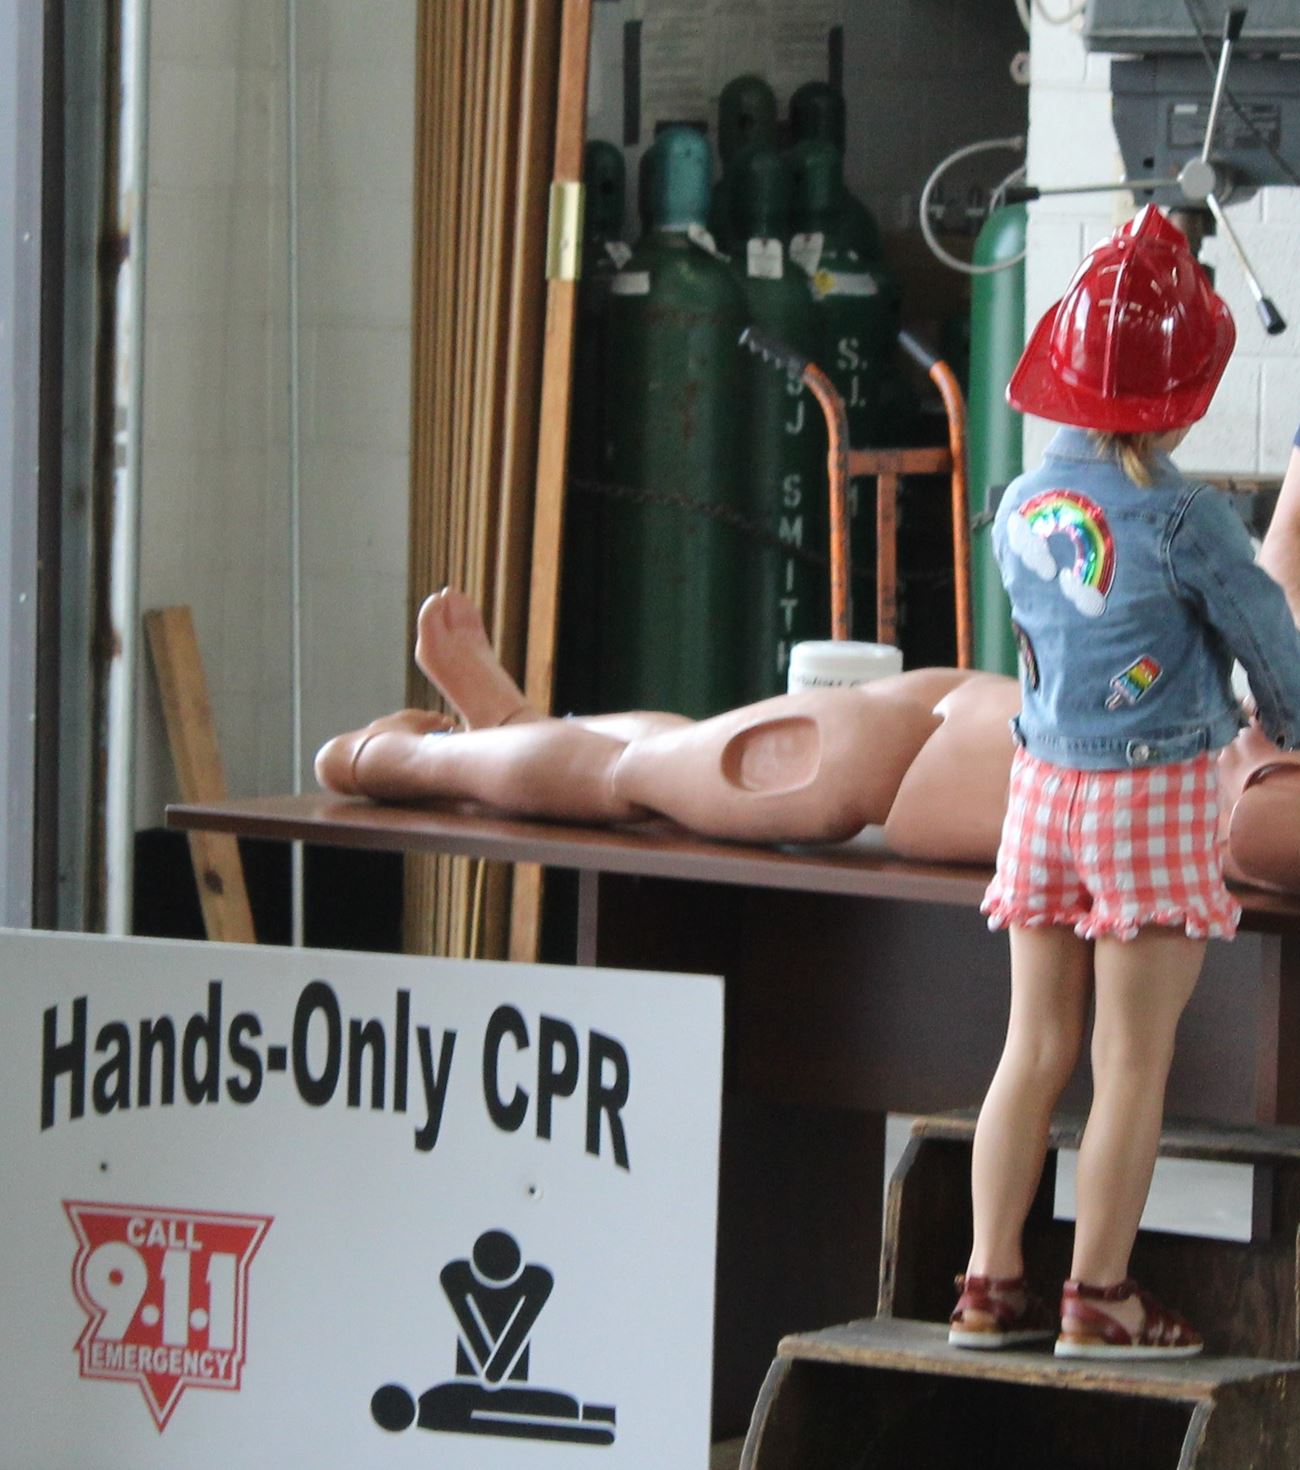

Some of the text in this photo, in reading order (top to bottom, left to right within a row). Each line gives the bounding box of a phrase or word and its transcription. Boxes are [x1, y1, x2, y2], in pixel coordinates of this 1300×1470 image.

[40, 979, 631, 1174] Hands-Only CPR
[127, 1217, 203, 1252] CALL
[91, 1342, 230, 1378] EMERGENCY
